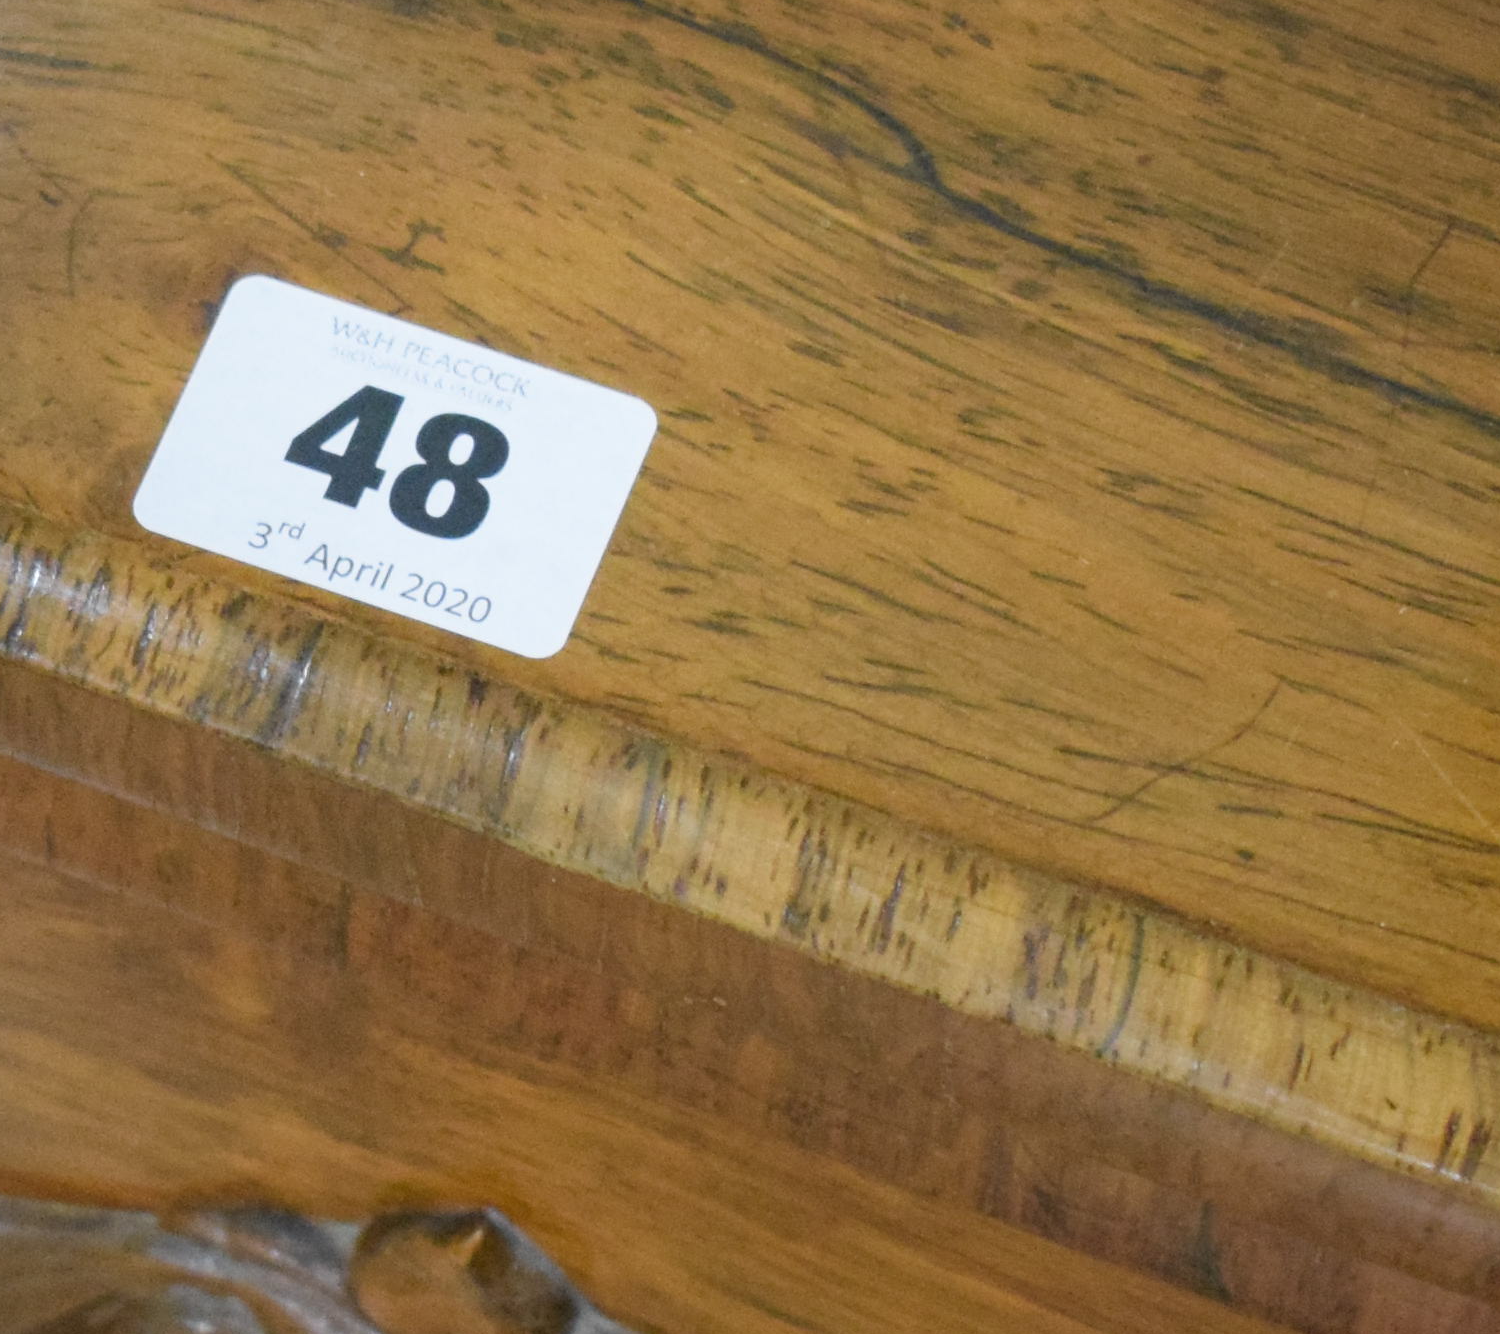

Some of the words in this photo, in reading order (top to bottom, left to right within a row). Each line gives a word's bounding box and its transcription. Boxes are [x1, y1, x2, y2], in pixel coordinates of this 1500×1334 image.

[332, 316, 394, 352] W&H
[403, 341, 531, 397] PEACOCK
[284, 385, 510, 540] 48
[248, 520, 306, 550] 3rd
[304, 543, 394, 591] April
[400, 573, 492, 624] 2020
